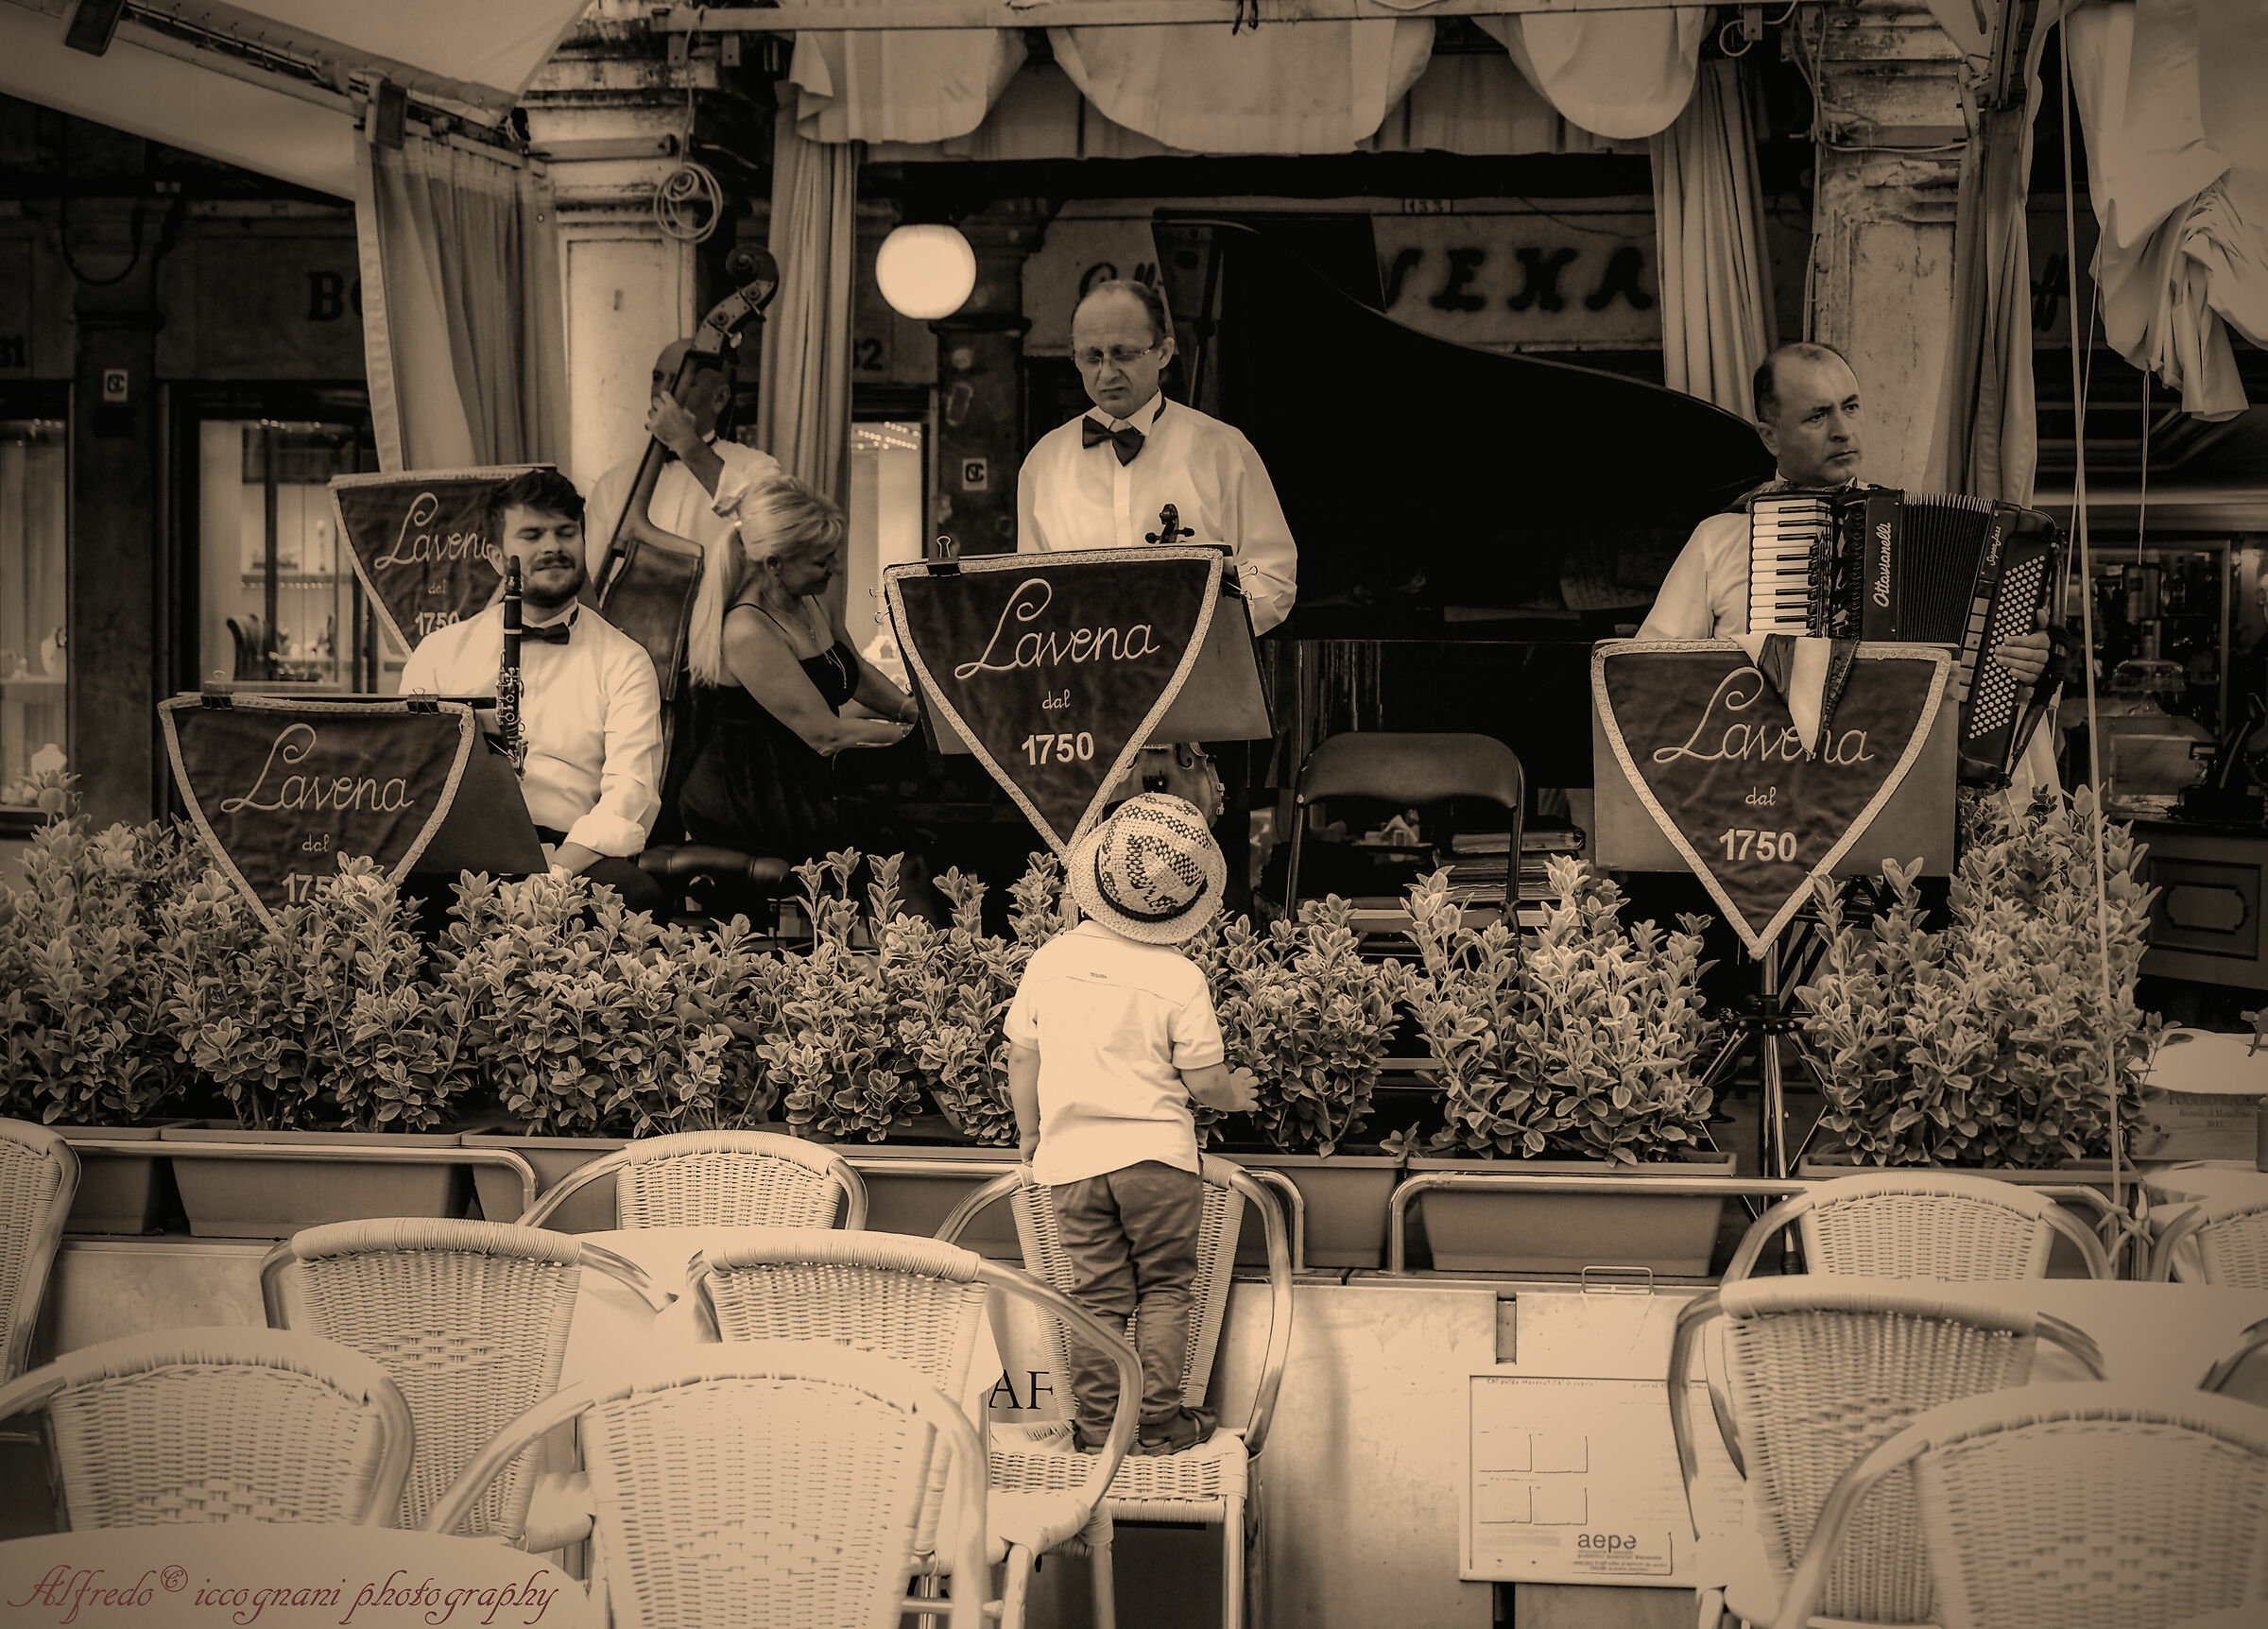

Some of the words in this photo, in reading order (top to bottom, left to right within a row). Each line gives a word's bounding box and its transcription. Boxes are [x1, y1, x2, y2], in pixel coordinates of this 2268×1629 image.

[954, 578, 1160, 679] Lavena
[1041, 689, 1071, 710] dal
[1022, 731, 1094, 766] 1750
[219, 723, 414, 813] Lavena
[1745, 786, 1777, 806] dal
[301, 833, 329, 852] dal
[1719, 829, 1797, 862] 1750
[282, 872, 334, 902] 175
